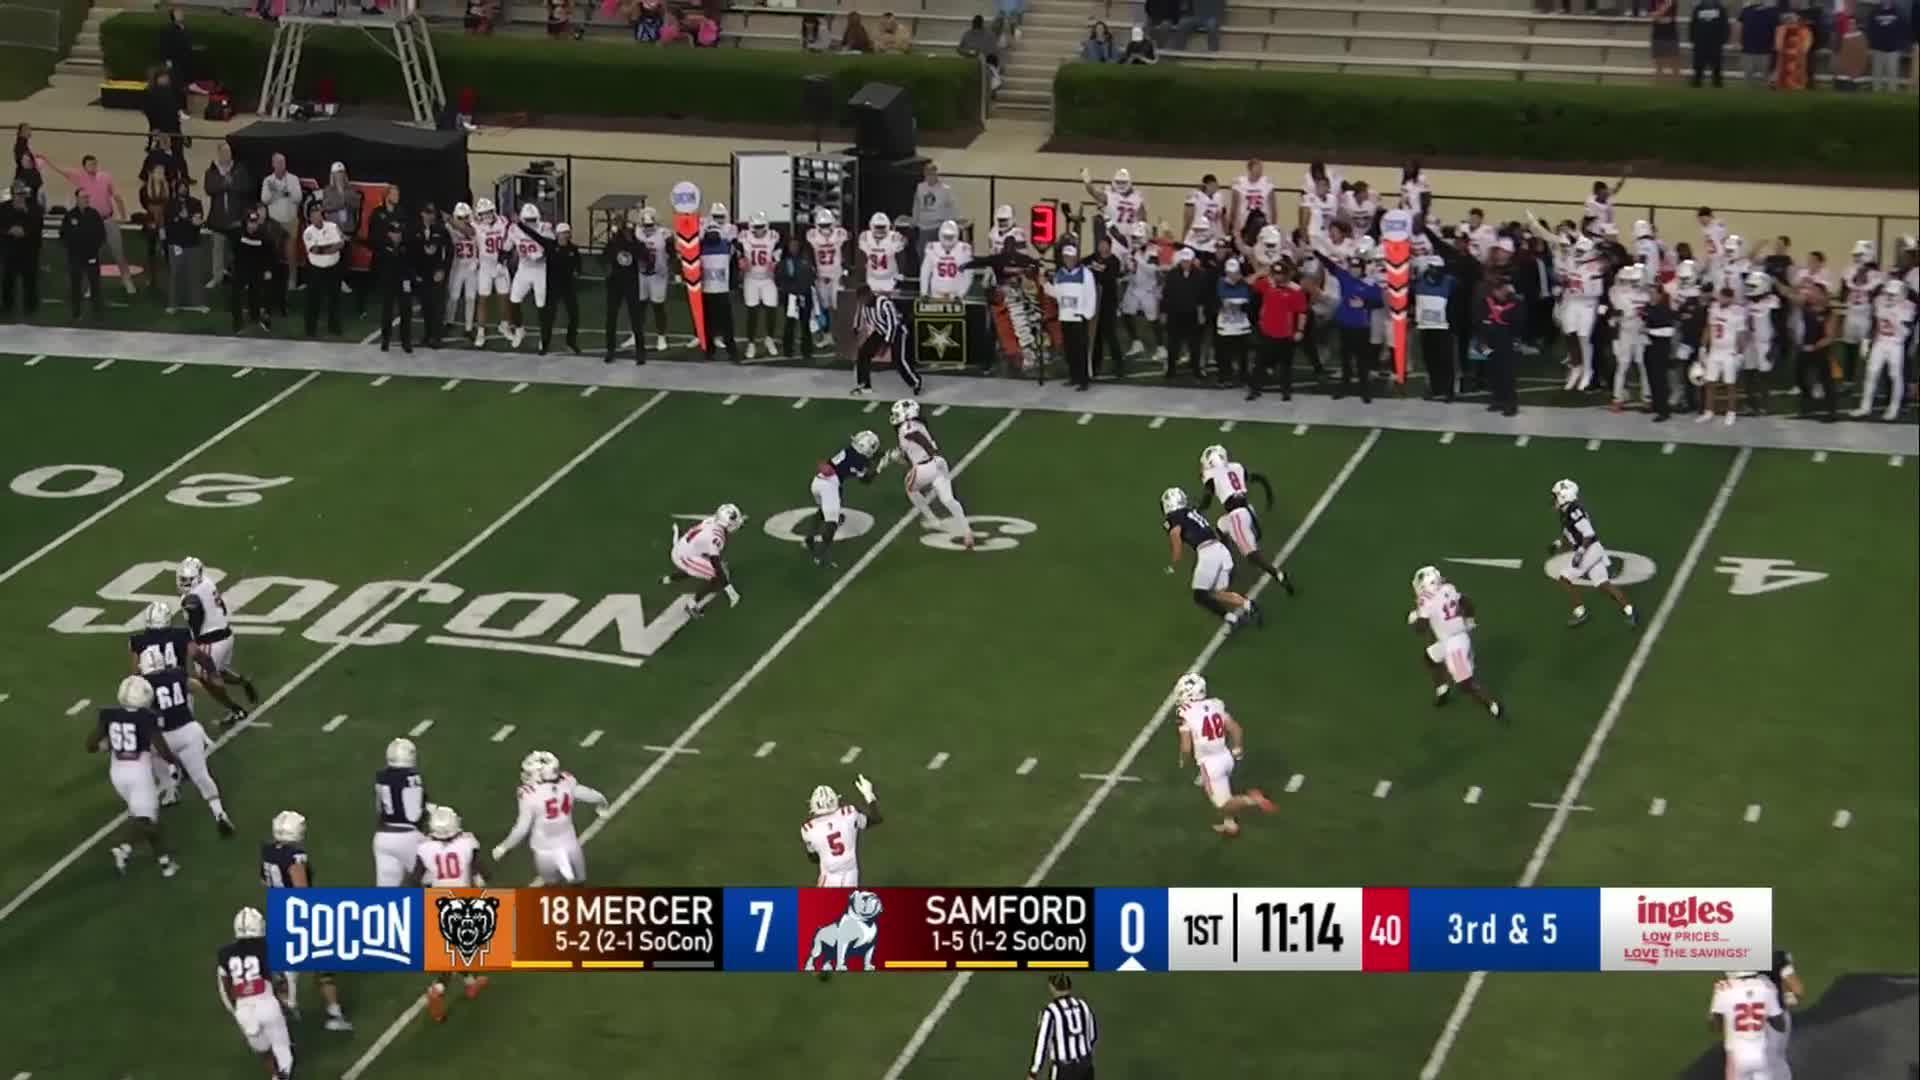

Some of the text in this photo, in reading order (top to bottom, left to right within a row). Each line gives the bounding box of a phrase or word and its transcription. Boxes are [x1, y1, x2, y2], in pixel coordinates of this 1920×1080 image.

[1033, 206, 1057, 244] 3
[938, 262, 959, 279] 50
[156, 681, 186, 710] 64
[108, 721, 137, 752] 65
[1201, 713, 1226, 741] 48
[544, 793, 572, 819] 54
[827, 831, 845, 857] 5
[434, 851, 461, 881] 10
[228, 957, 257, 984] 22
